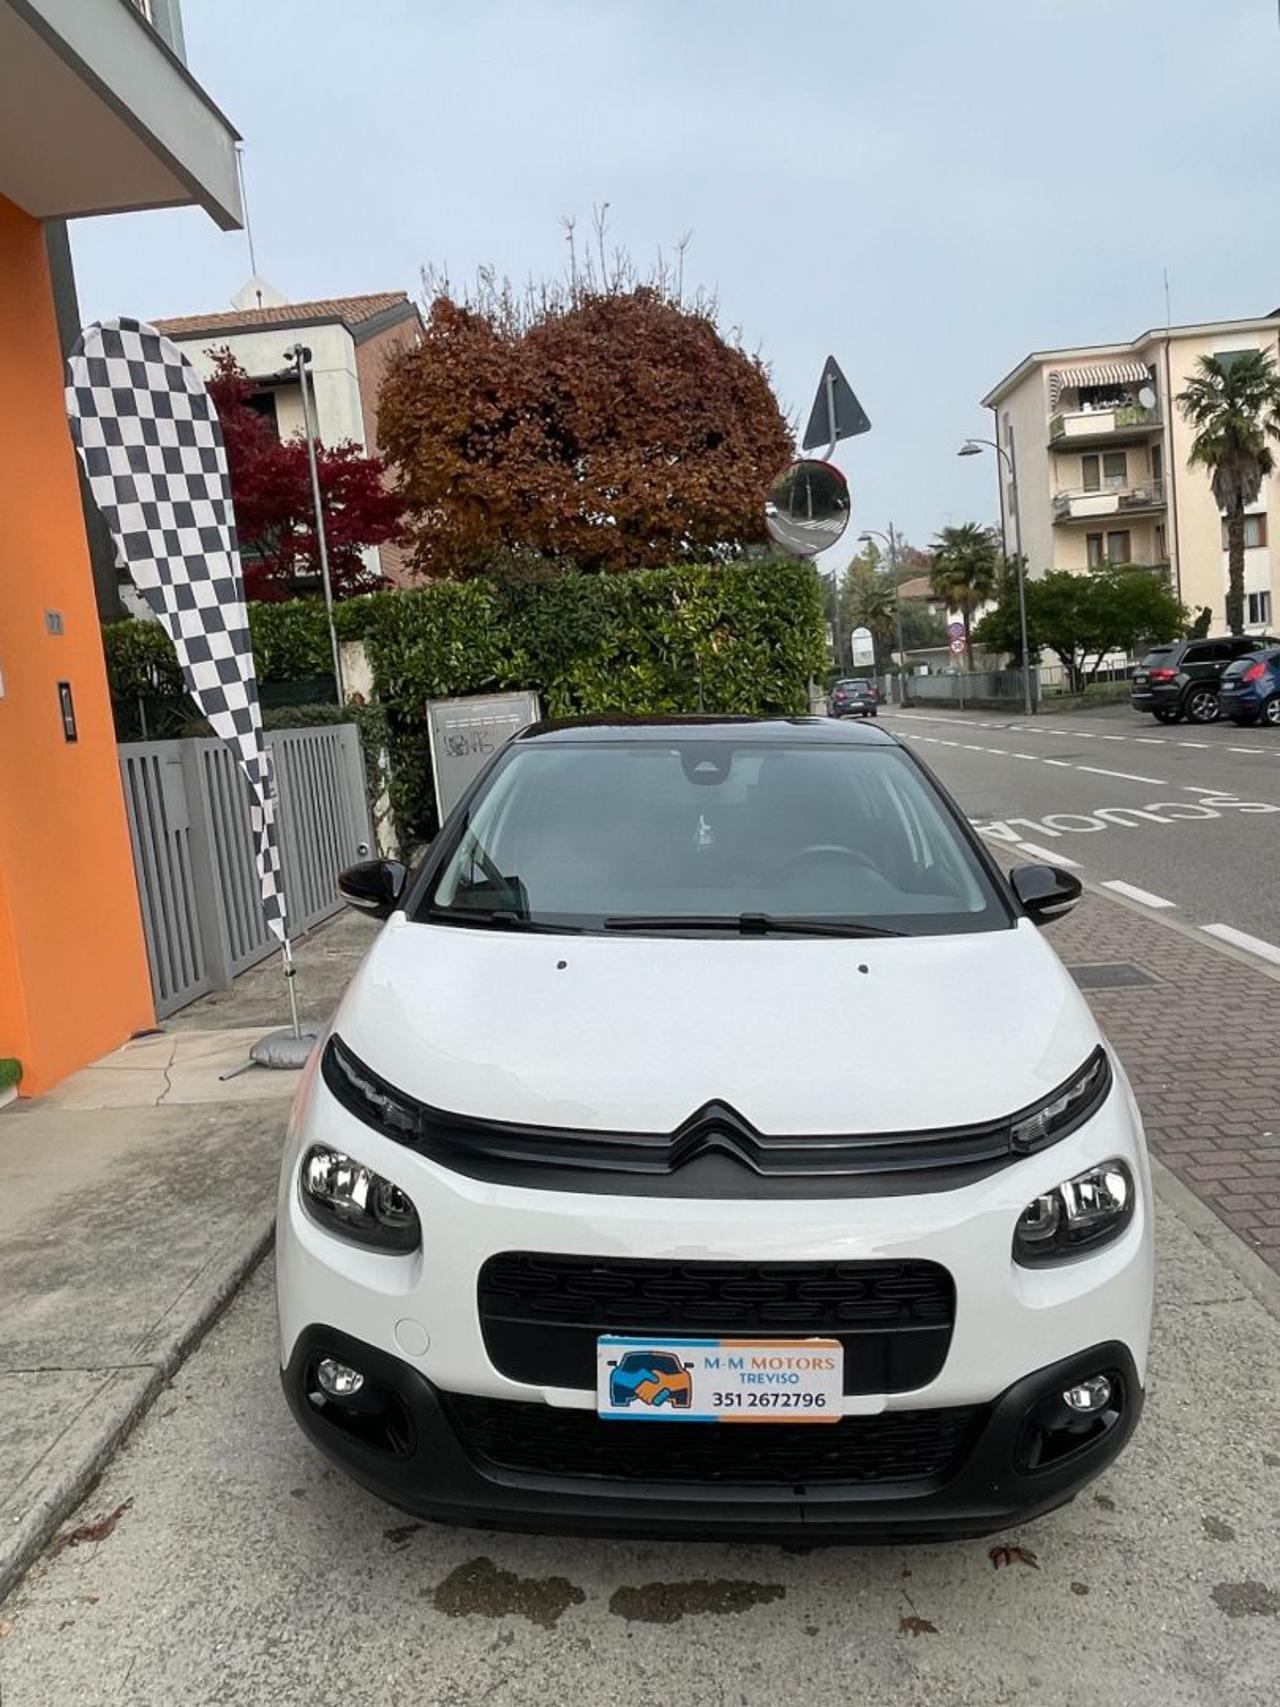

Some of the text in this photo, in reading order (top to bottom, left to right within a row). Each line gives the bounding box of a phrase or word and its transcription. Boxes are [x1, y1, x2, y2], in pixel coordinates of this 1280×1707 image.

[973, 797, 1280, 842] SCUOLA
[751, 1357, 836, 1370] MOTORS
[739, 1373, 800, 1385] TREVISO
[712, 1392, 826, 1408] 351 2672796
